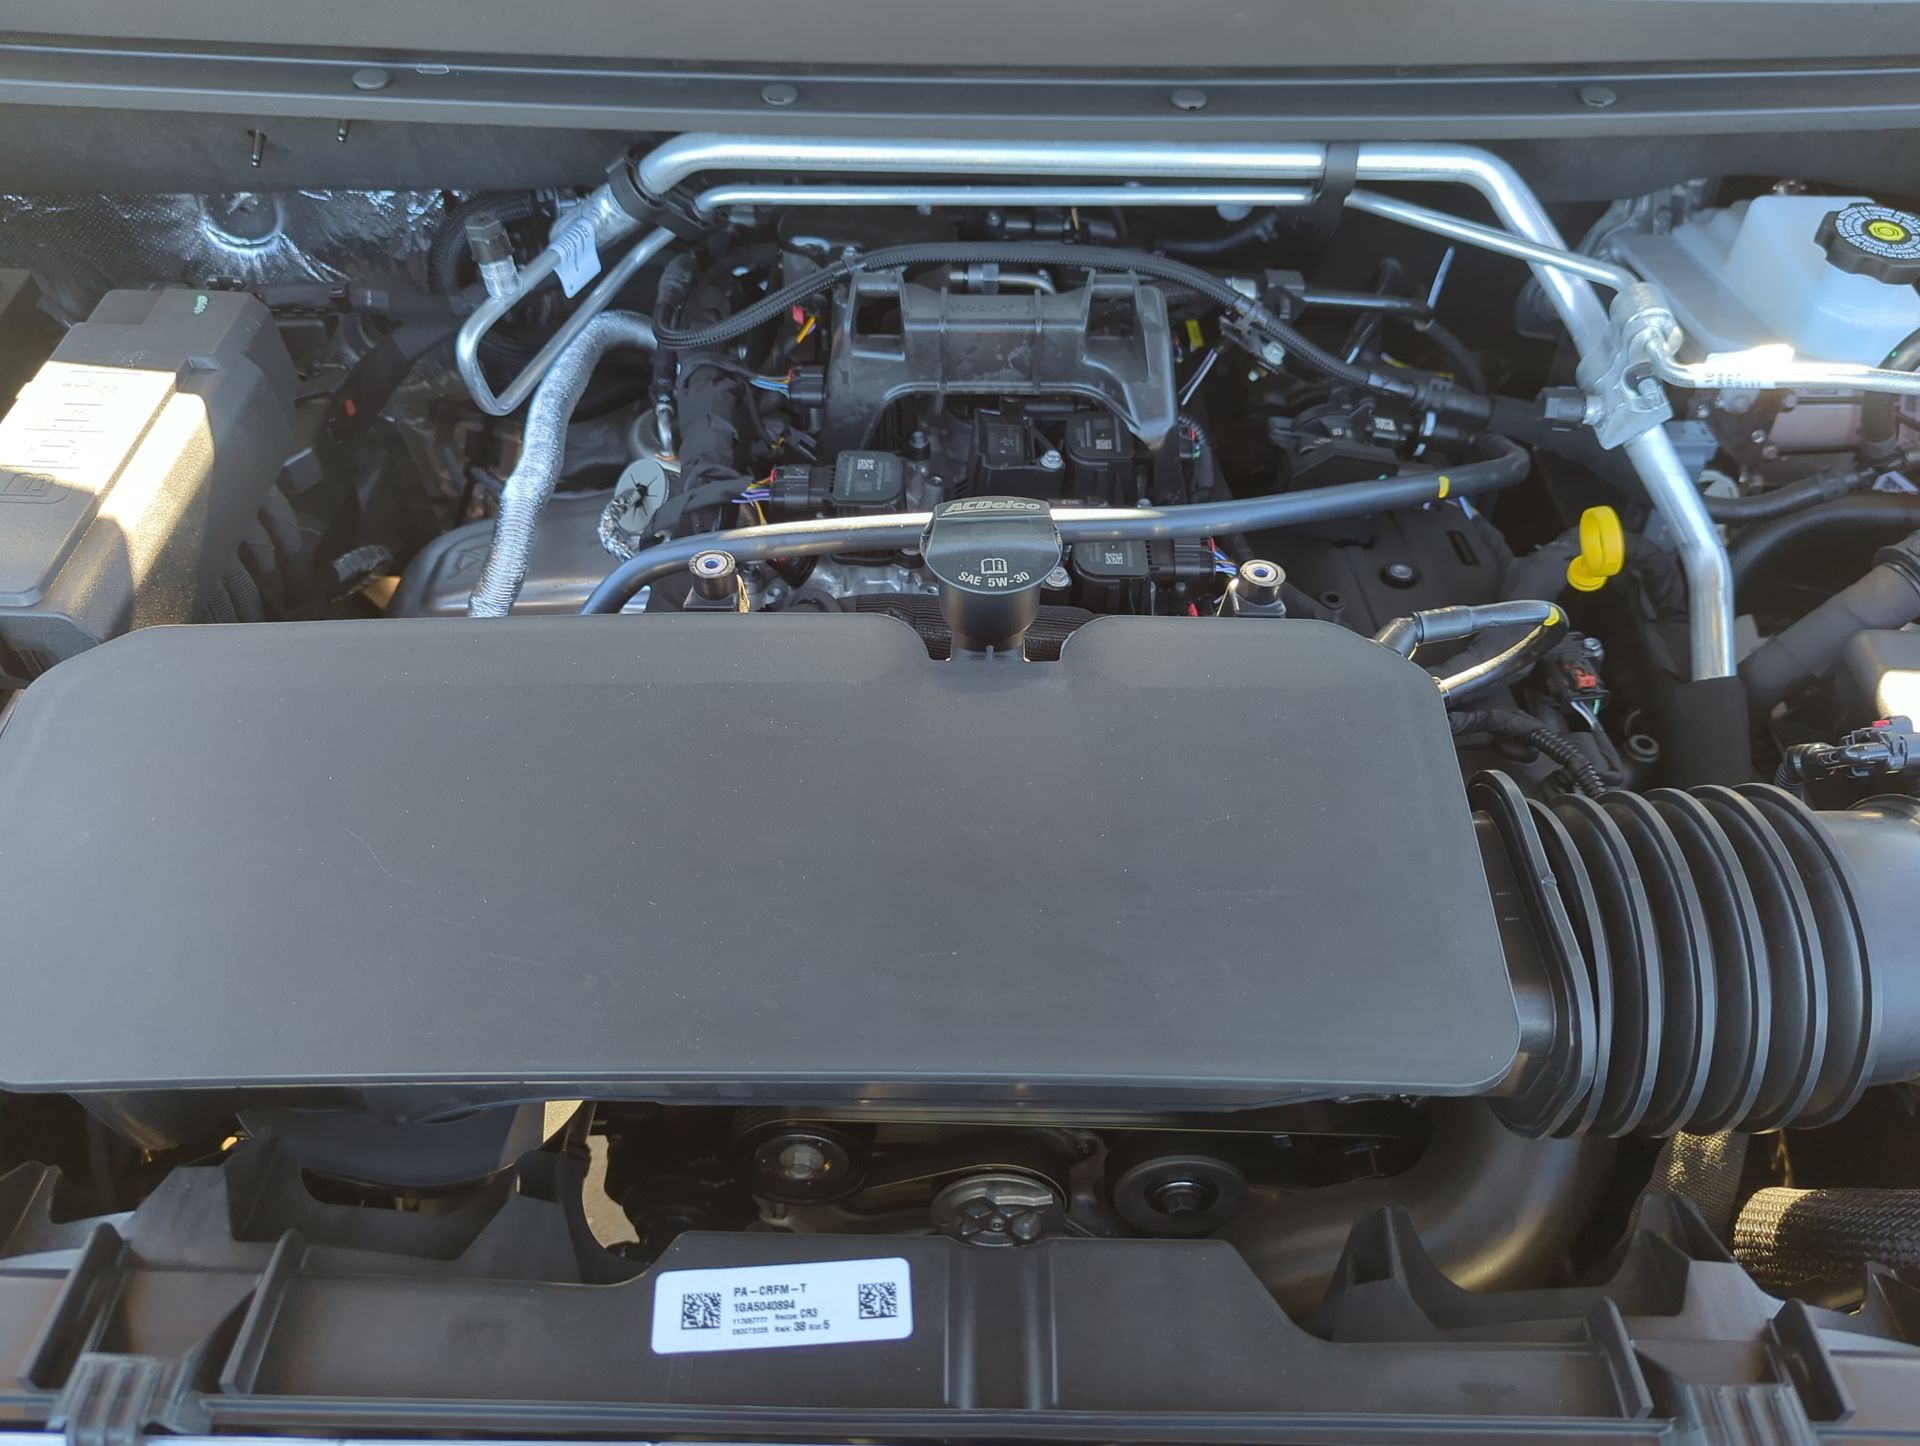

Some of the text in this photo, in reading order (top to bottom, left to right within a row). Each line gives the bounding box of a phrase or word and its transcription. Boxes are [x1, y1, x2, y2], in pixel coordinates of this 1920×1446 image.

[944, 500, 1041, 514] ACDelco
[958, 571, 1030, 587] SAE 5W-30
[799, 1308, 818, 1319] CR3
[793, 1321, 807, 1332] 38
[823, 1319, 830, 1330] 5
